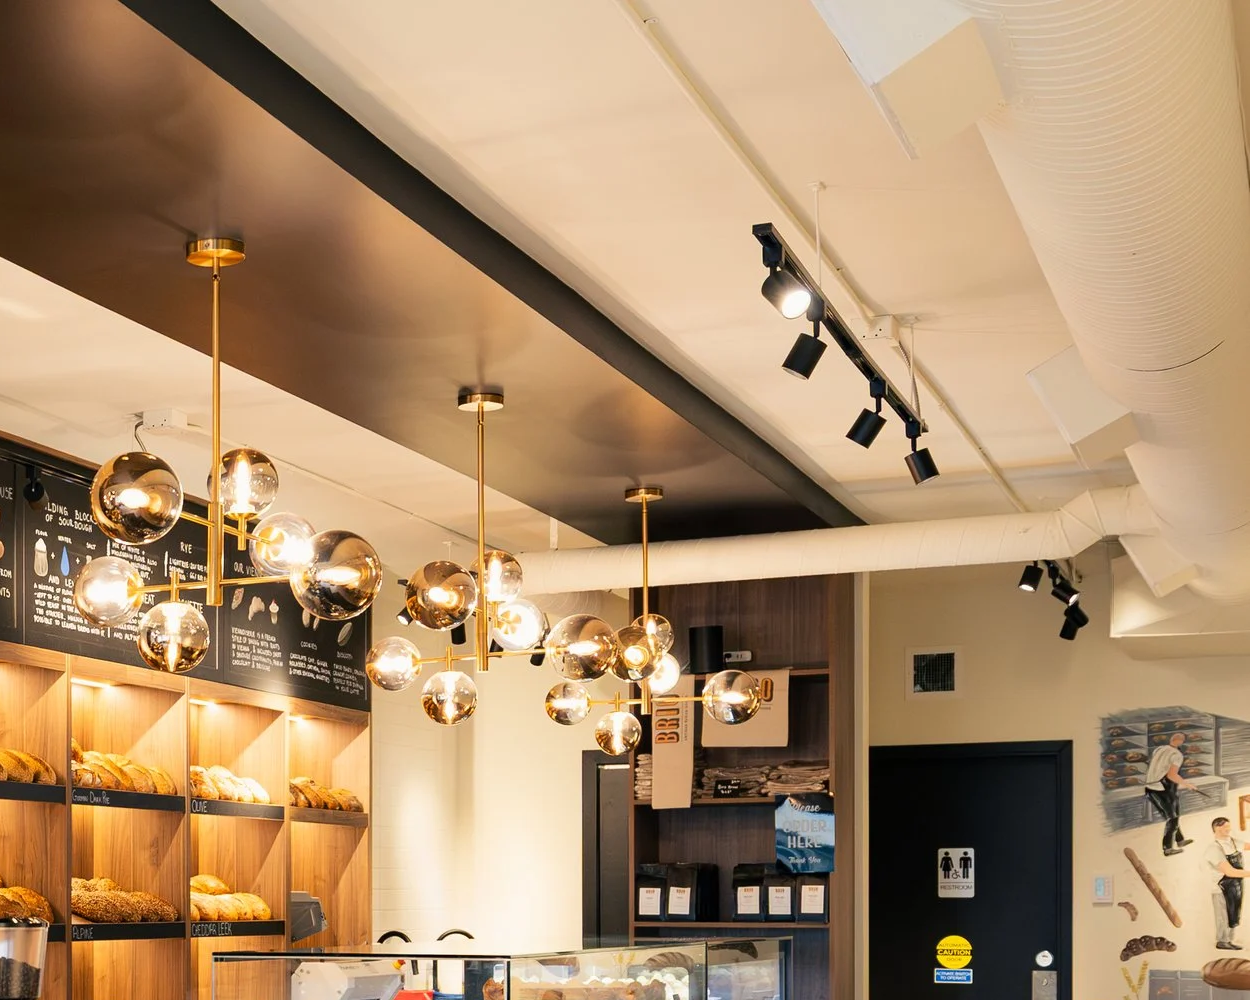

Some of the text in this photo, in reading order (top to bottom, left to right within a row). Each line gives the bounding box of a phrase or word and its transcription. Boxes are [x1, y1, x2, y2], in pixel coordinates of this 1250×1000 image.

[45, 513, 93, 533] OF SOURDOUGH
[180, 541, 192, 554] RYE
[234, 562, 244, 577] OUR
[301, 641, 317, 650] COOKIES
[191, 800, 208, 813] OLIVE
[783, 819, 827, 833] ORDER
[787, 835, 822, 848] HERE
[808, 856, 821, 864] You
[72, 926, 94, 940] ALPINE
[218, 922, 233, 936] LEEK
